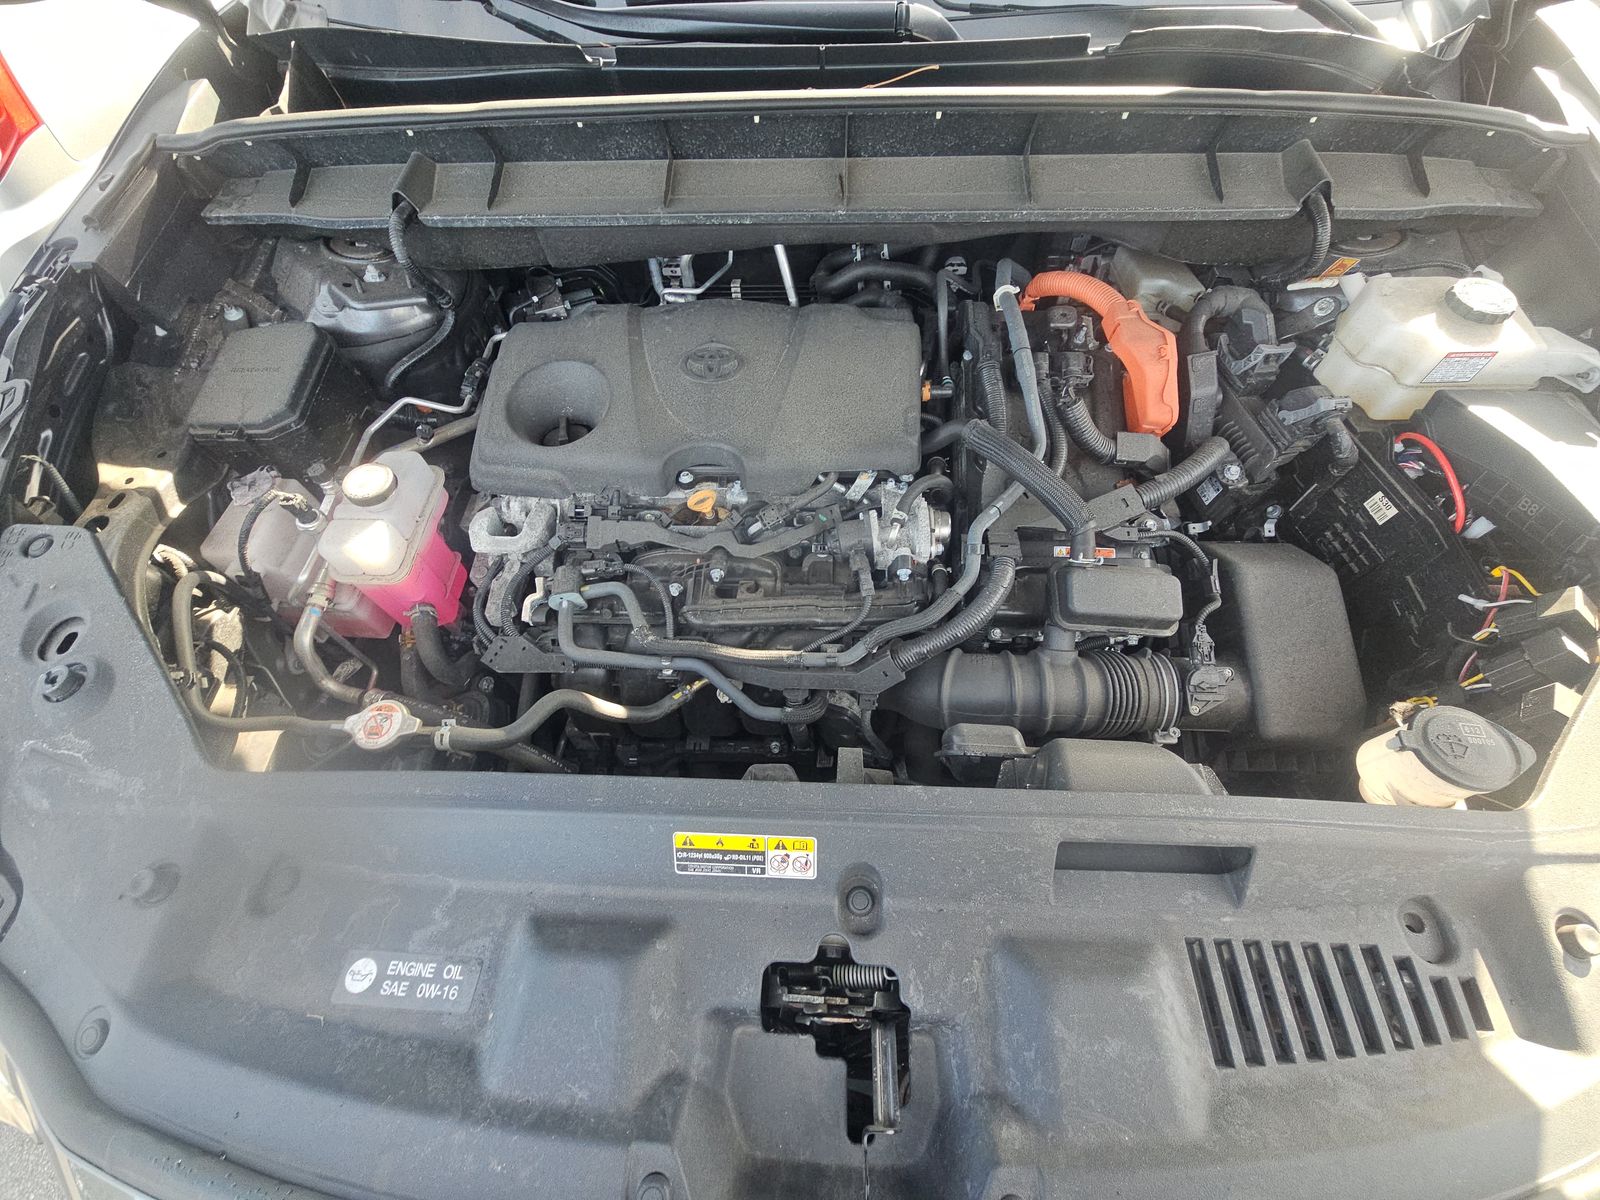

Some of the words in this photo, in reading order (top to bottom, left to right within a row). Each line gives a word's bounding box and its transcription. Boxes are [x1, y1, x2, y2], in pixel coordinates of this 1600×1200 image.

[1378, 495, 1393, 511] S30
[1517, 497, 1540, 516] B8
[386, 960, 437, 978] ENGINE
[443, 964, 464, 980] OIL
[380, 980, 410, 997] SAE
[416, 983, 460, 1000] 0W-16
